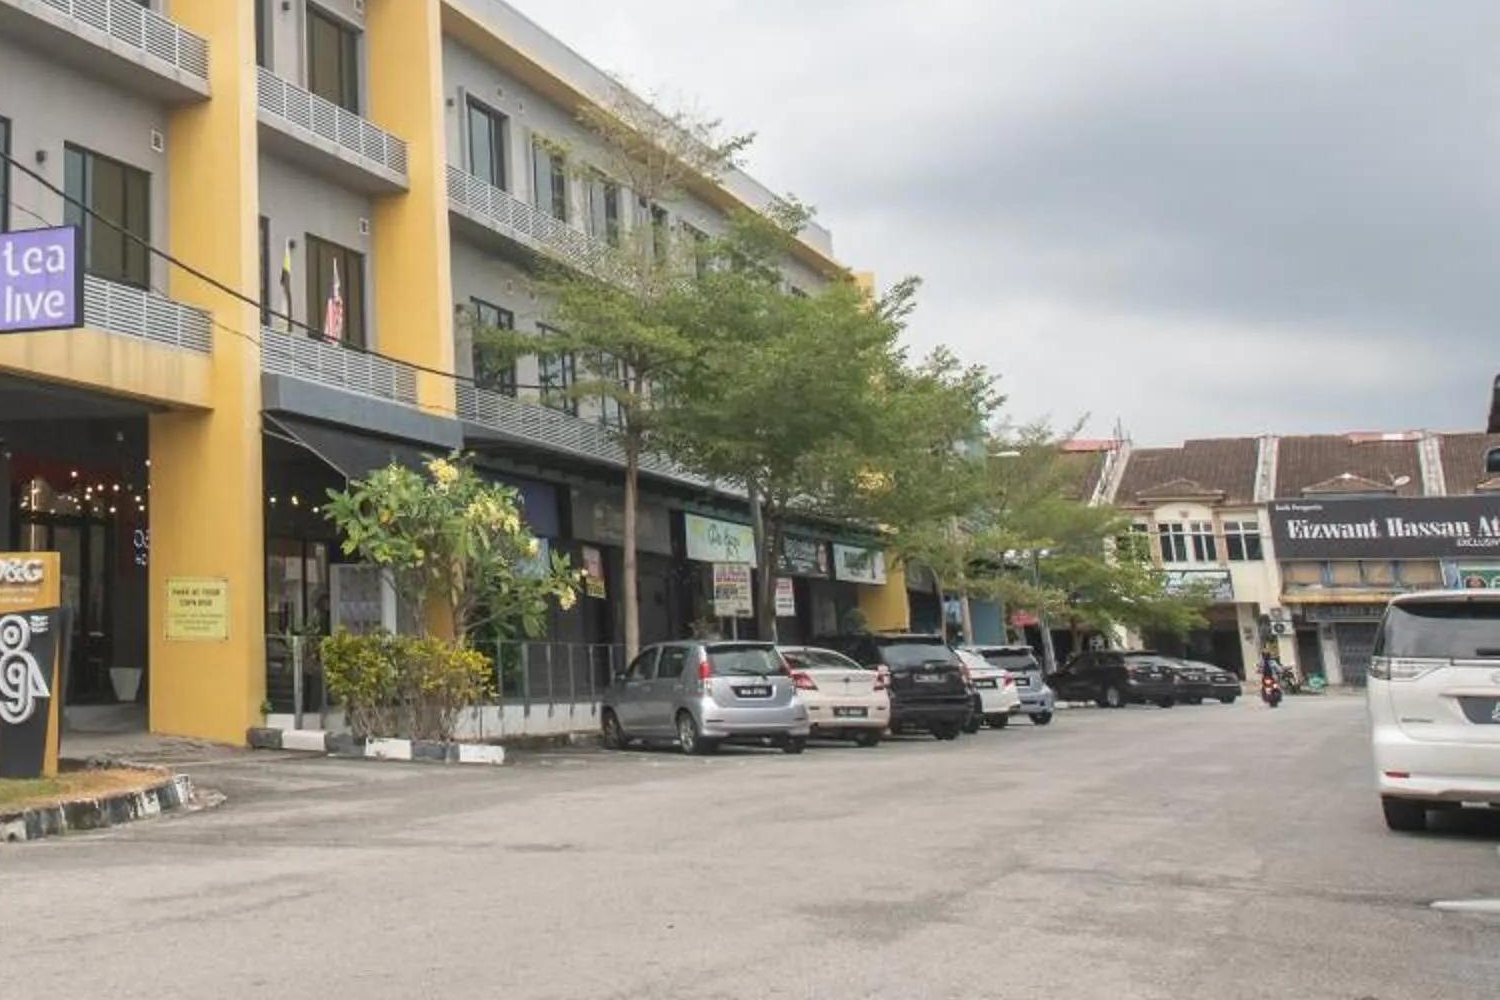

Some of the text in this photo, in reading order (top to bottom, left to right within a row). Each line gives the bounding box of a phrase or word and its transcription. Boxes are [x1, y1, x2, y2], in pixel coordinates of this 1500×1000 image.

[3, 241, 65, 277] tea
[4, 285, 65, 324] live
[1385, 517, 1471, 537] Hassan
